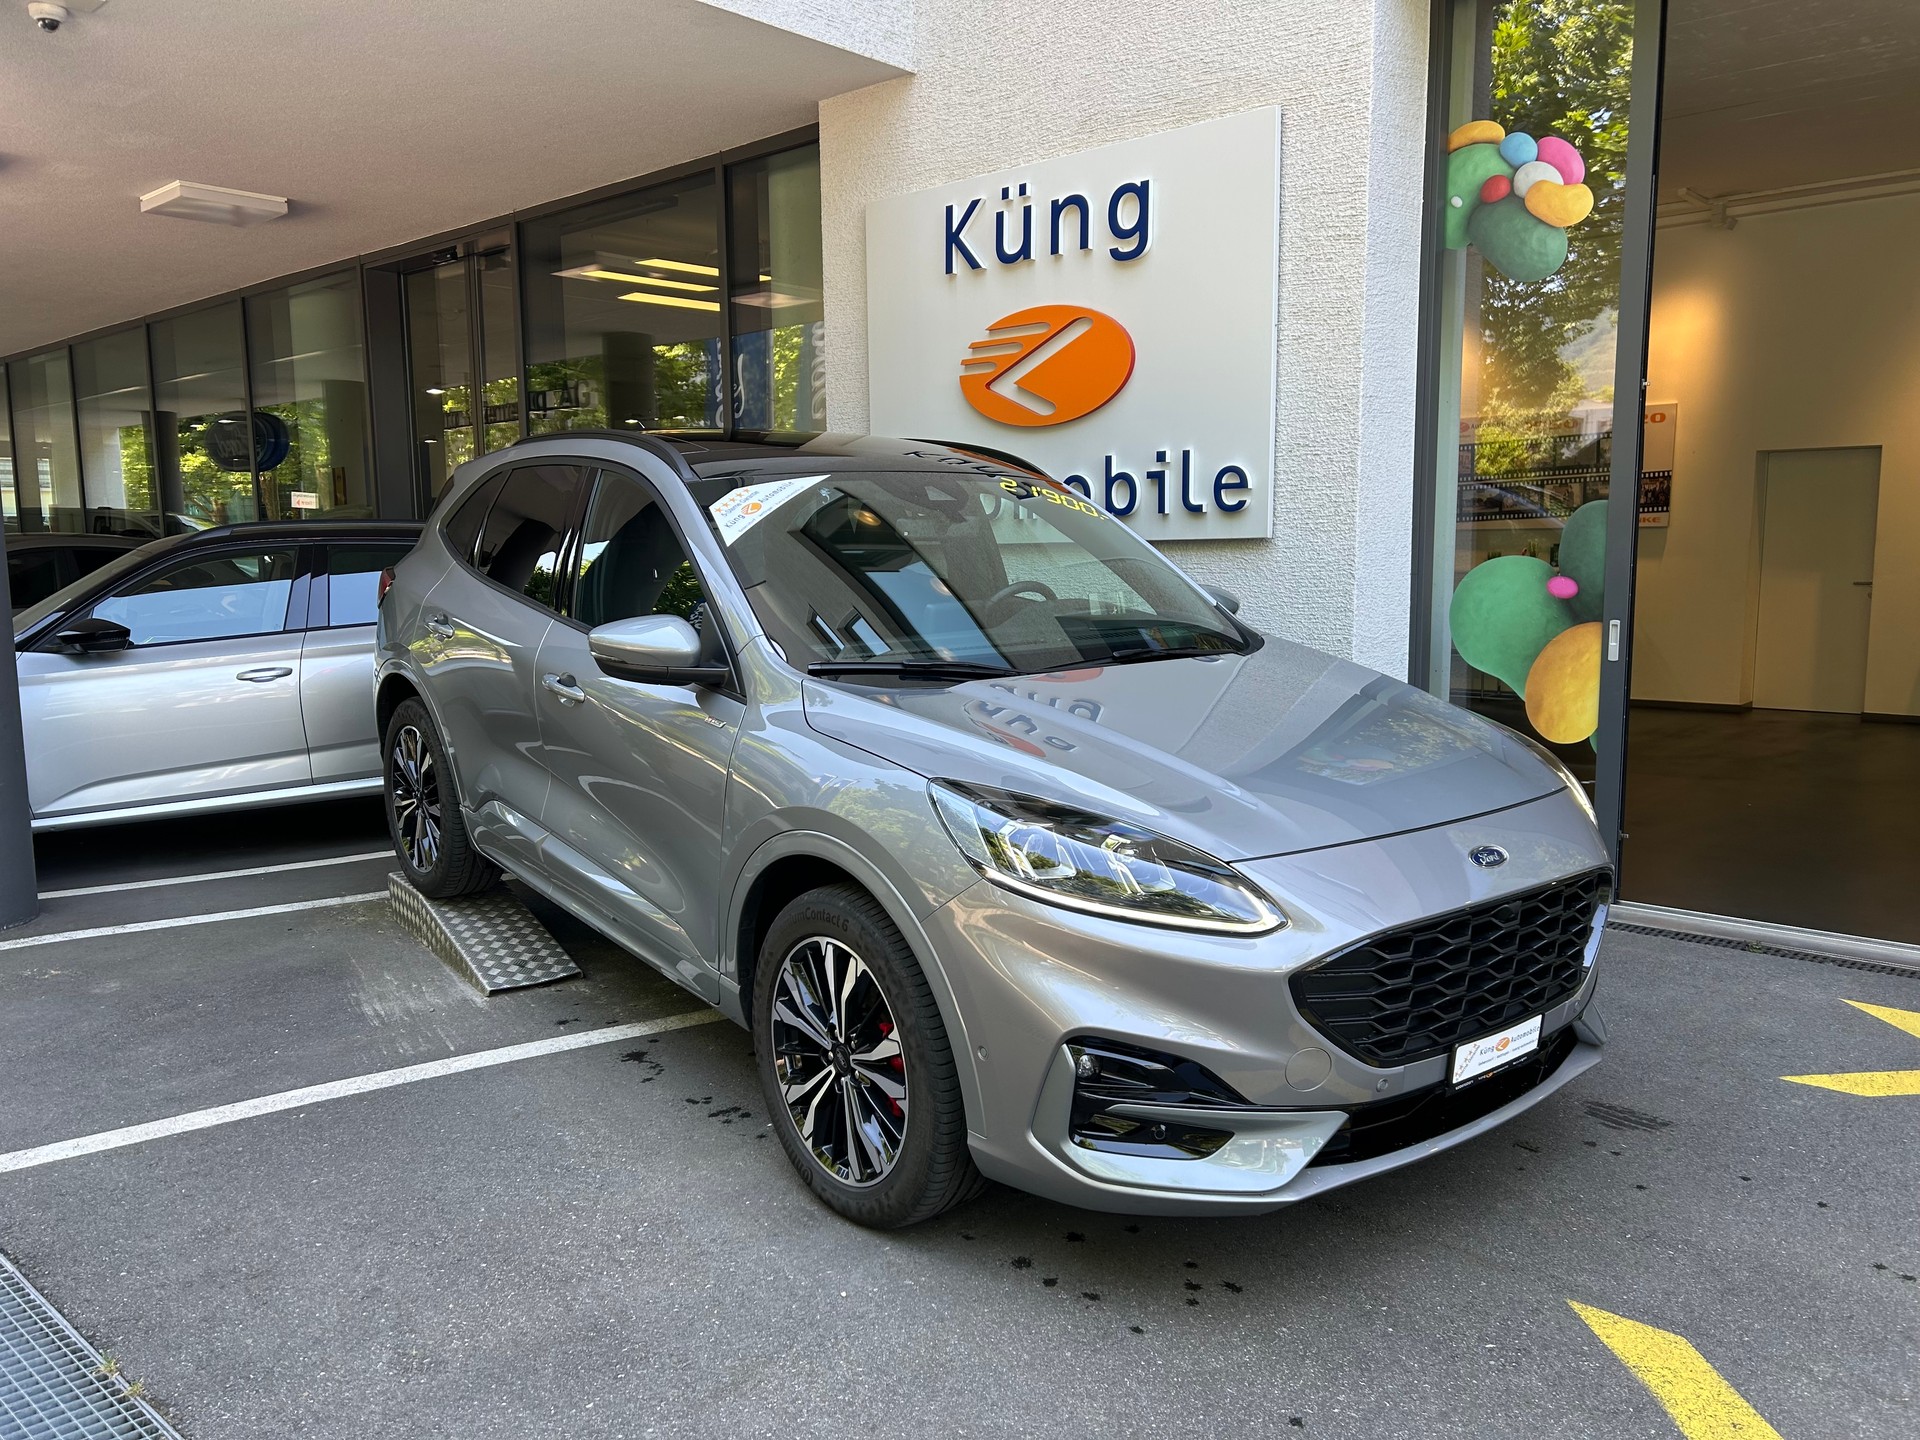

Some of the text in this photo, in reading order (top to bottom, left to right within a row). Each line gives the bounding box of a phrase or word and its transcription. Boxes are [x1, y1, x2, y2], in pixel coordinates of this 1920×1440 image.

[944, 178, 1153, 276] Küng
[1062, 449, 1253, 516] obile
[724, 514, 746, 528] Küng
[841, 919, 850, 932] 6
